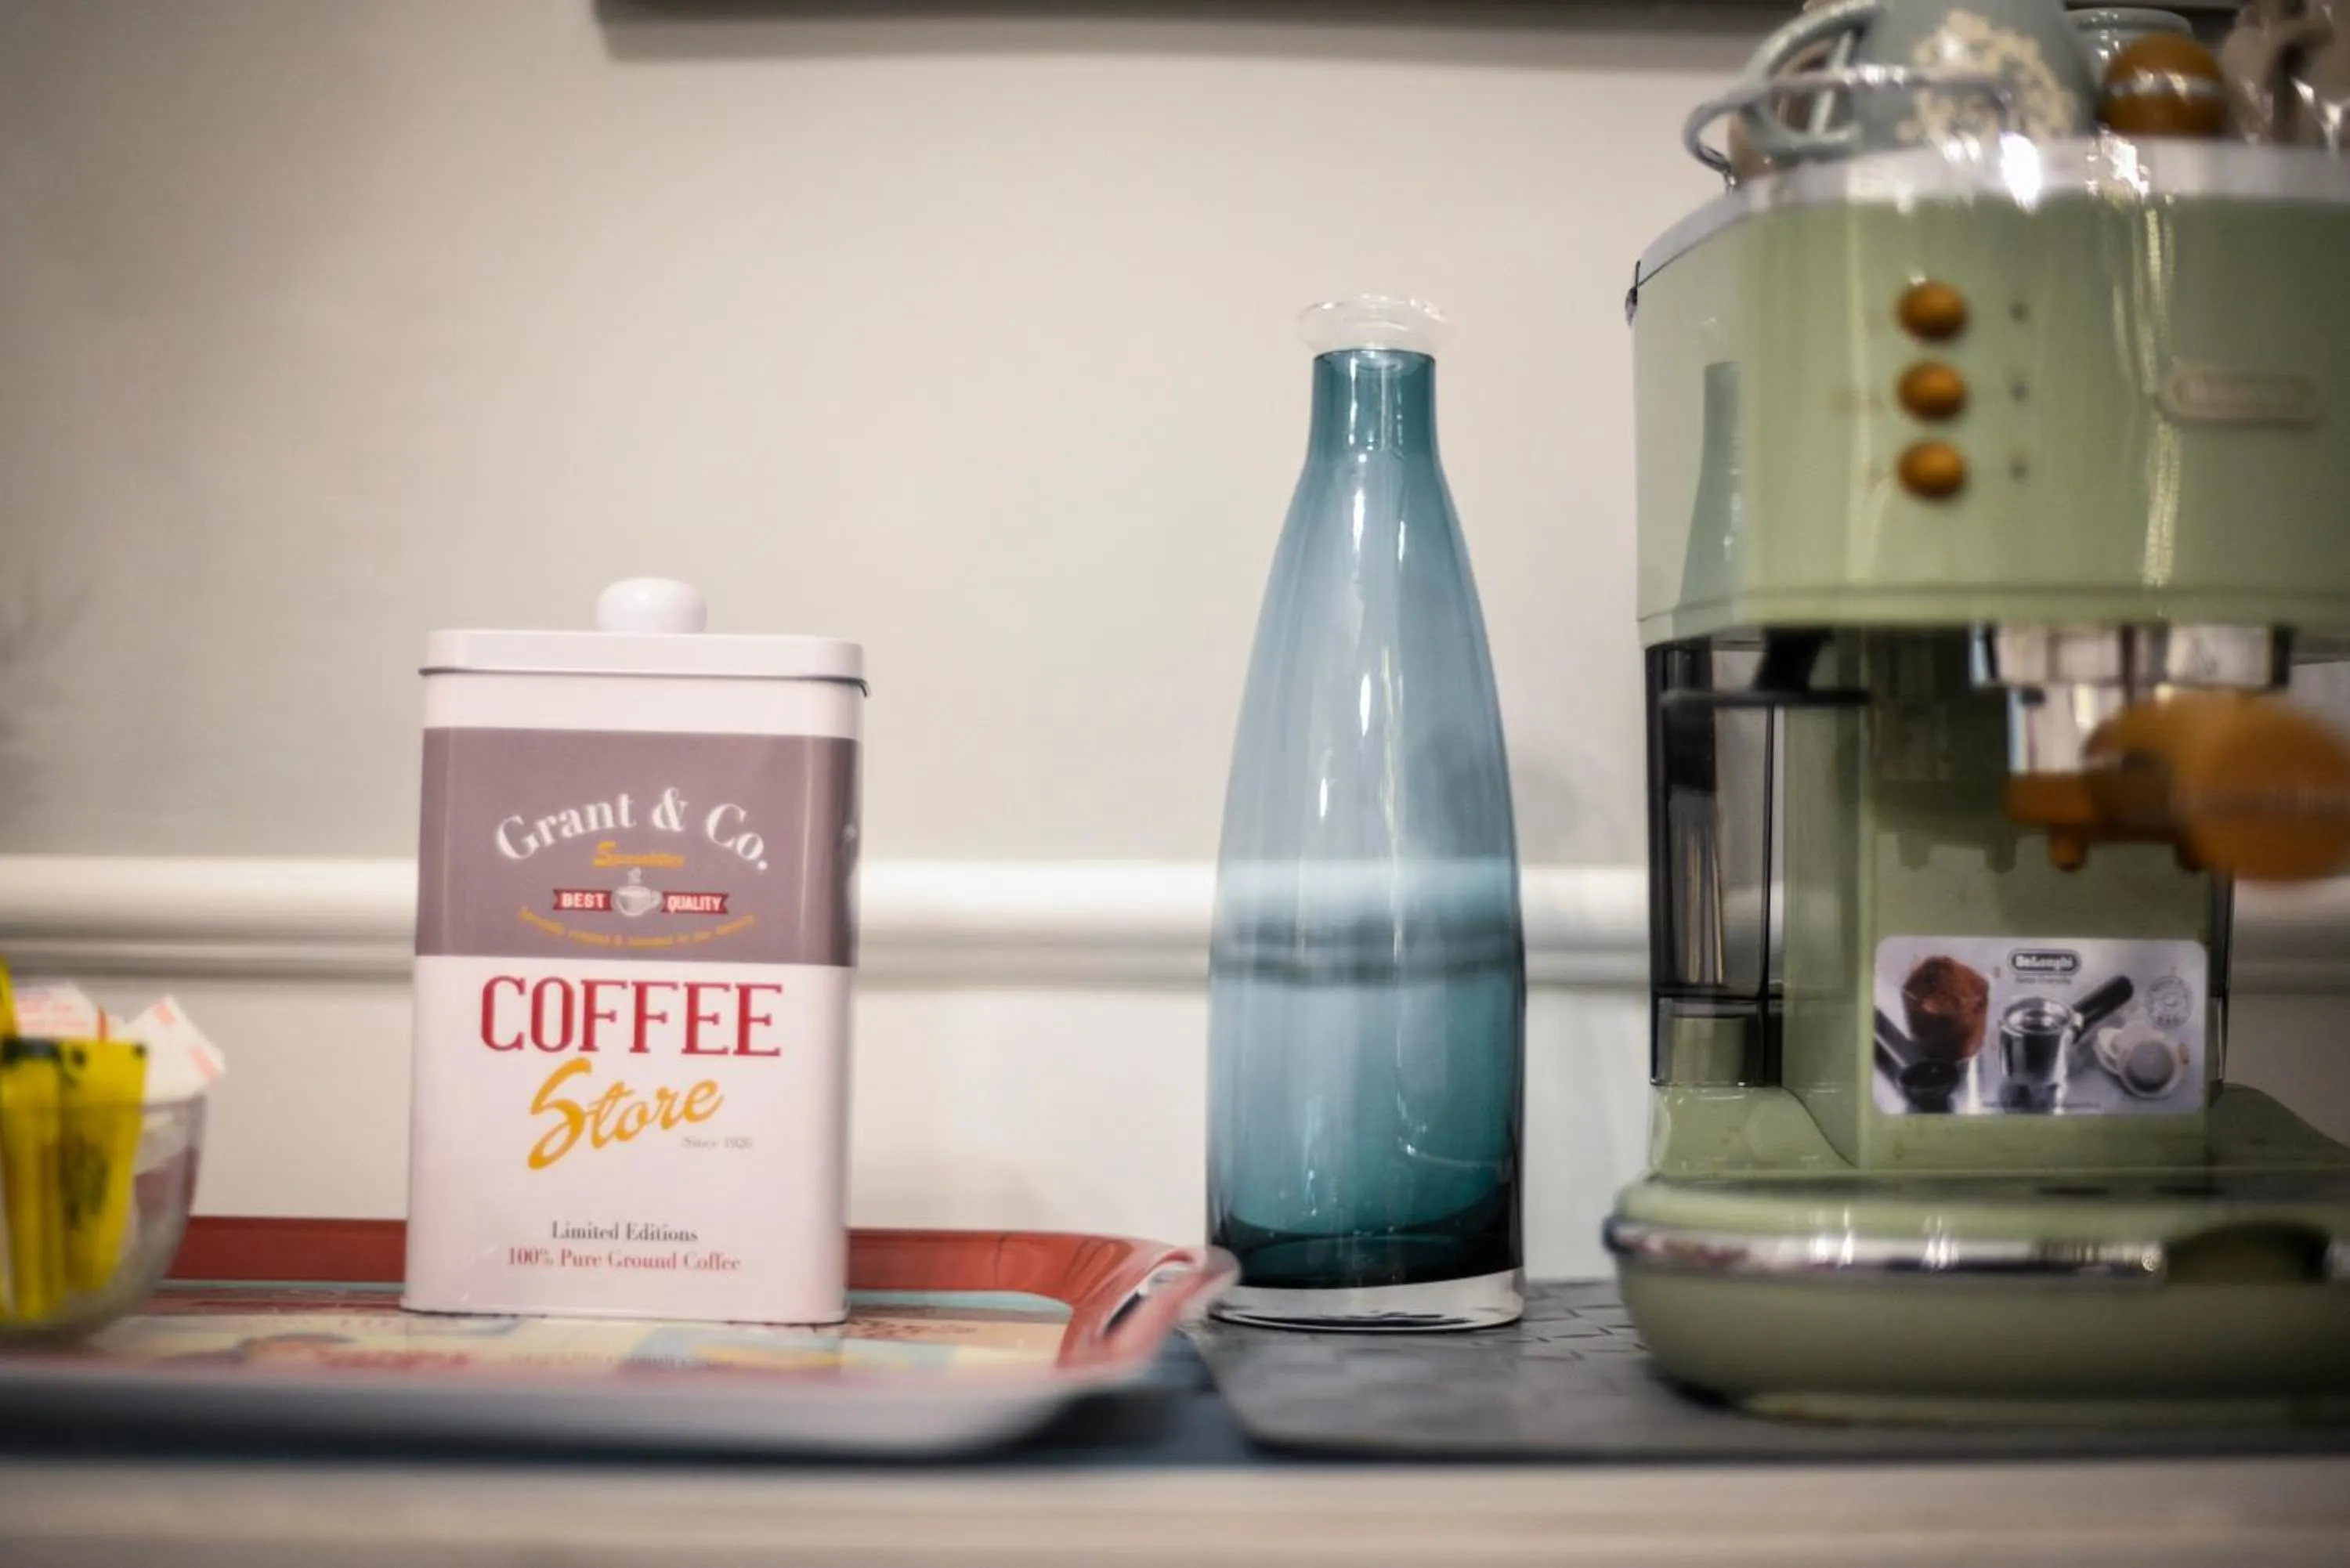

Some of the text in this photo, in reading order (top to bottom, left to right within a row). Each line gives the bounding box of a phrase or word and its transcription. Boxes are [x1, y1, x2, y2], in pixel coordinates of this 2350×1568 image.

[495, 793, 637, 860] Grant
[652, 786, 688, 833] &
[706, 803, 768, 871] Co.
[560, 892, 721, 913] BEST QUALITY
[480, 975, 783, 1057] COFFEE
[527, 1057, 724, 1170] Store
[551, 1221, 698, 1242] Limited Editions
[560, 1248, 602, 1267] Pure
[608, 1250, 677, 1270] Ground
[684, 1251, 741, 1270] Coffee
